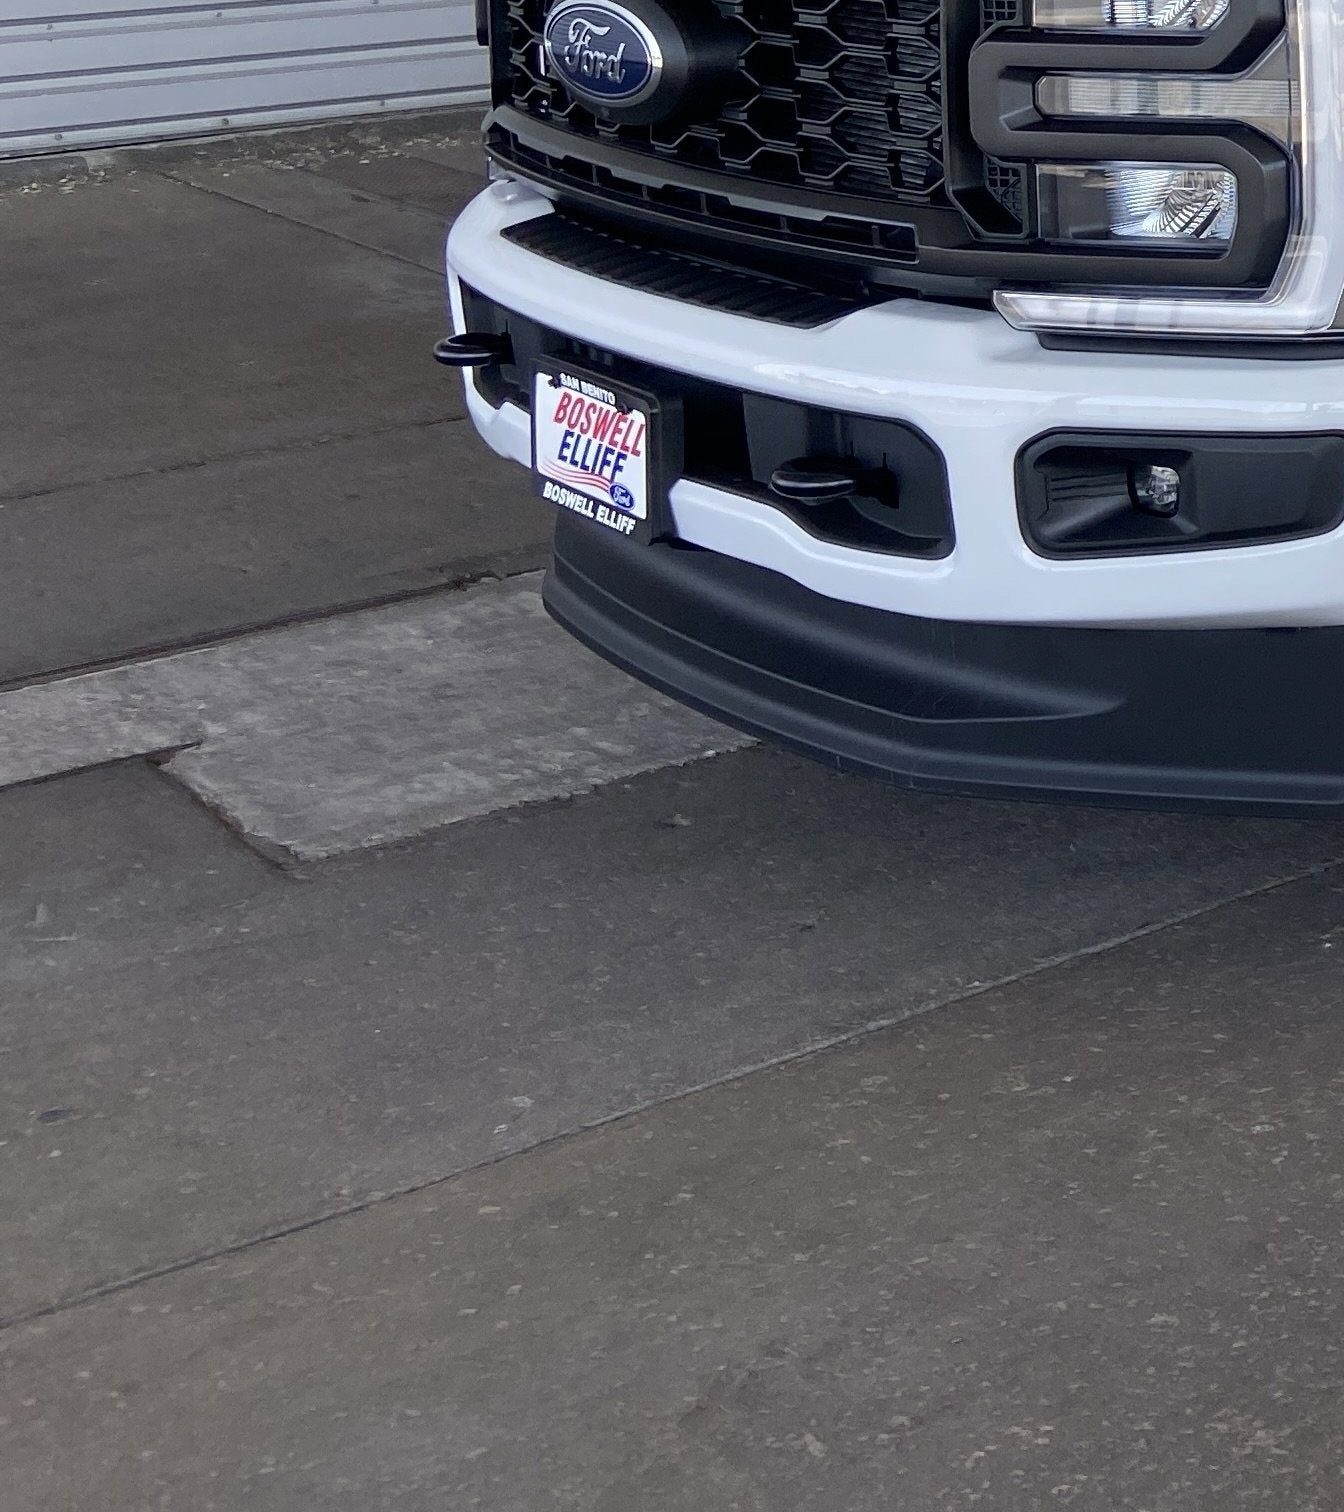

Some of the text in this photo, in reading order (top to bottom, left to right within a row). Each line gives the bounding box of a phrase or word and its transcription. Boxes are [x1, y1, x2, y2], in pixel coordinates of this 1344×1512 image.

[564, 17, 626, 85] Ford
[560, 372, 616, 406] SAN BENITO
[553, 391, 646, 457] BOSWELL
[558, 429, 628, 484] ELLIFF
[543, 481, 638, 535] BOSWELL ELLIFF
